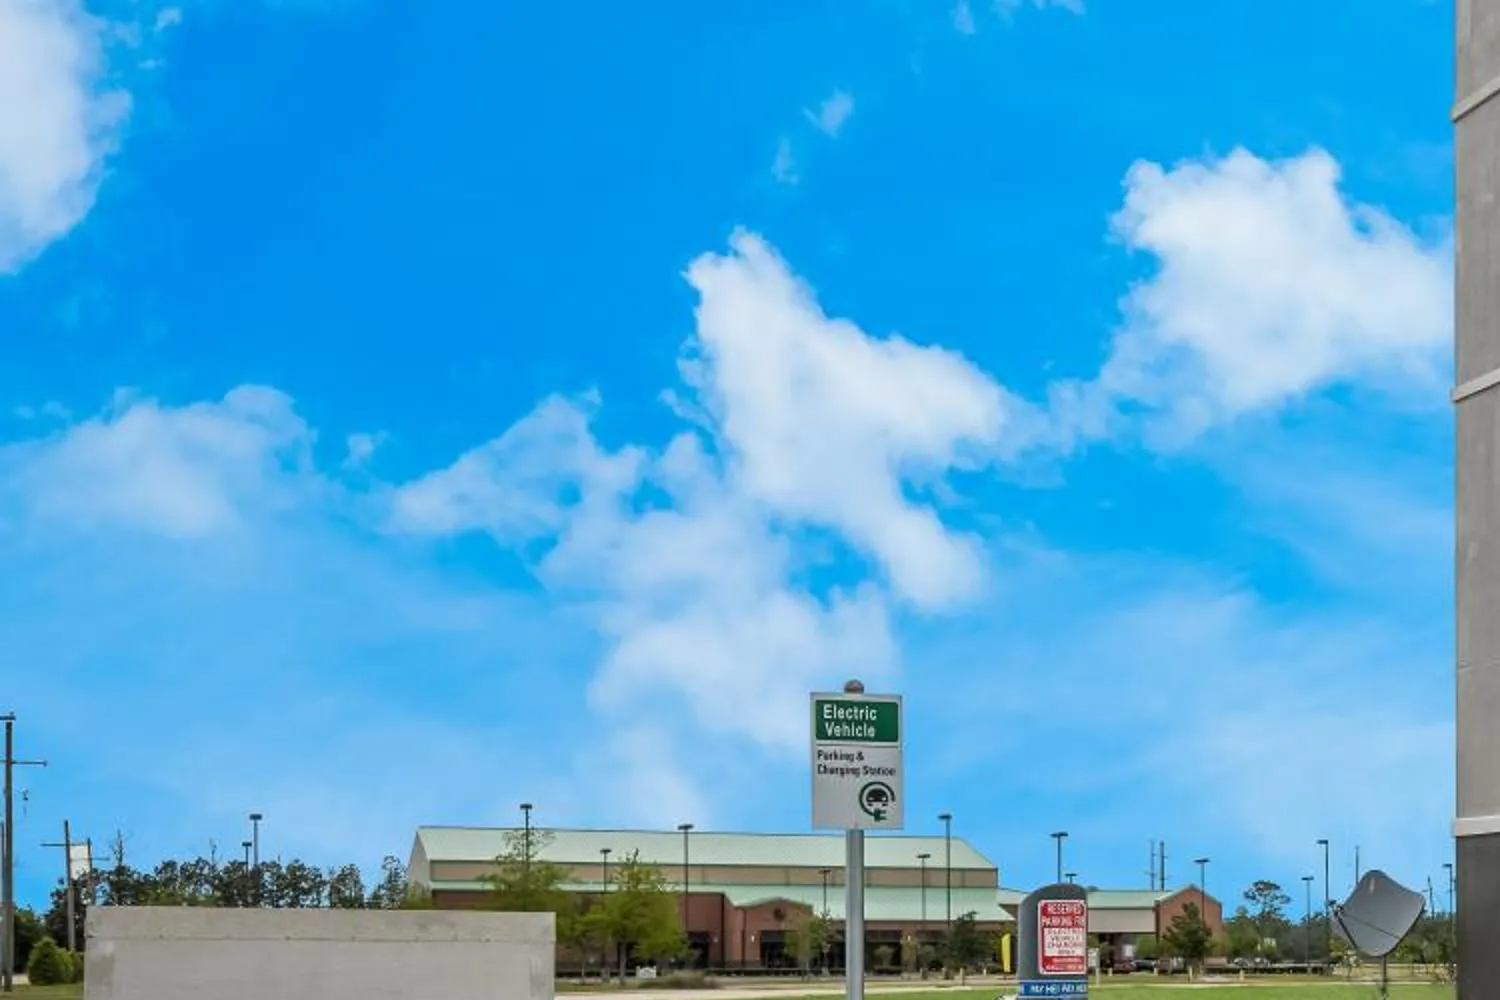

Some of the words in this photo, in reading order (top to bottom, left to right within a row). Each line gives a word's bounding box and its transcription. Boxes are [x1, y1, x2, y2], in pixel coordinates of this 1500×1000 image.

[823, 703, 877, 721] Electric
[824, 721, 876, 738] Vehicle
[817, 749, 855, 763] Parking
[856, 751, 864, 761] &
[817, 763, 860, 778] Charging
